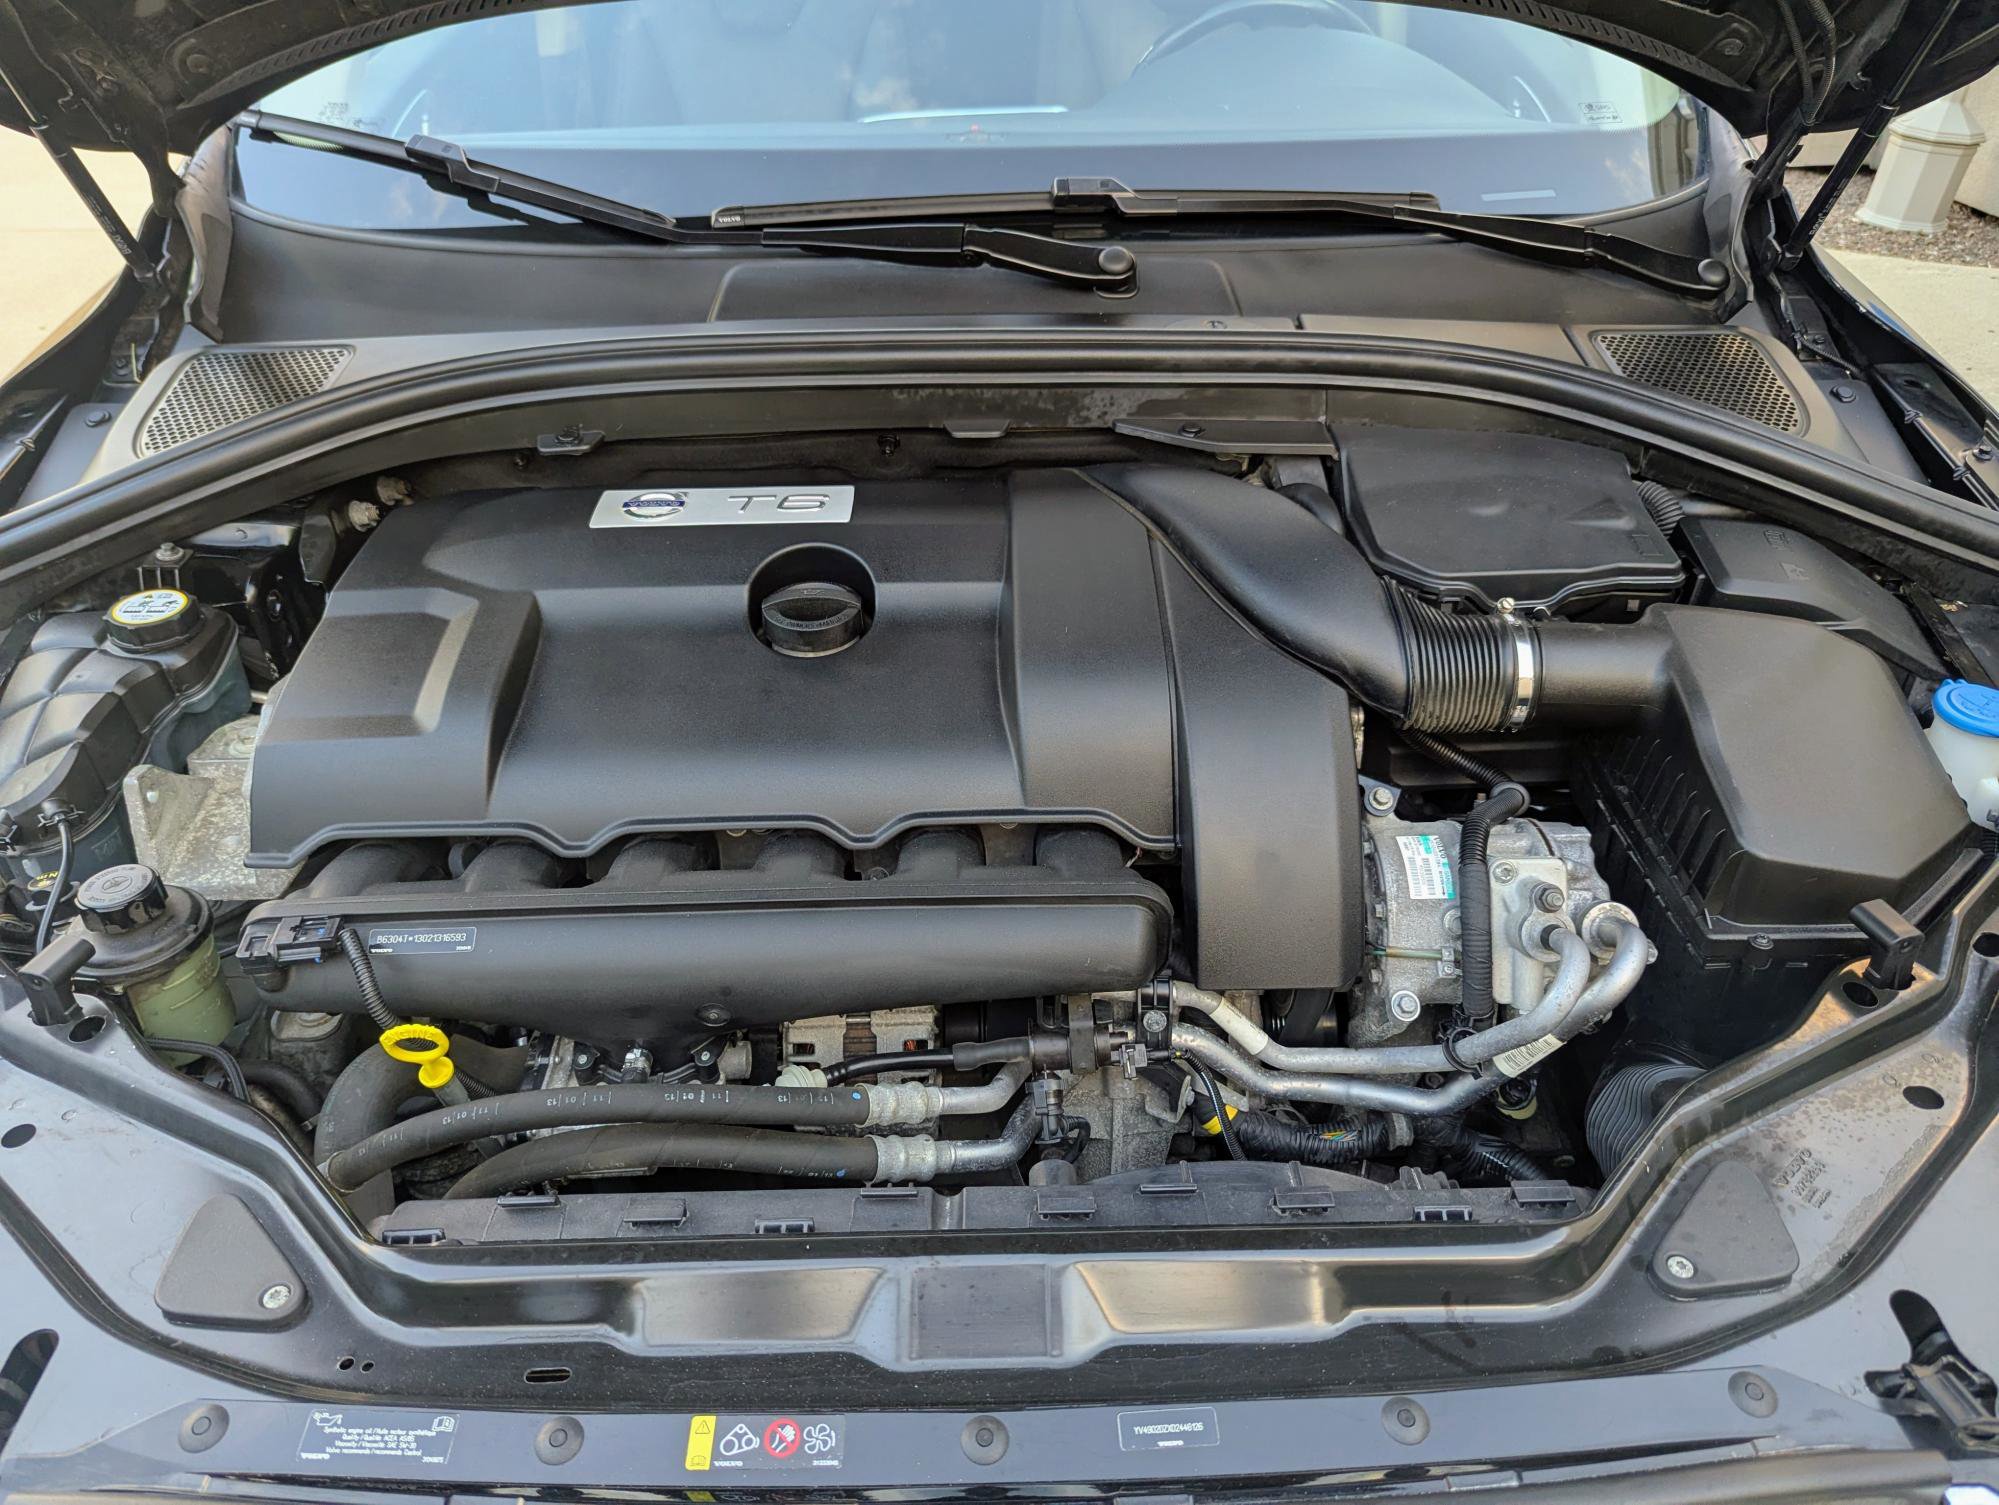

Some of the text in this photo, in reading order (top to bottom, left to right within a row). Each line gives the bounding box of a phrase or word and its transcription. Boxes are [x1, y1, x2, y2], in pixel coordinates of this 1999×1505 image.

[626, 493, 831, 514] VOLVO T6
[1433, 837, 1448, 859] VOLVO
